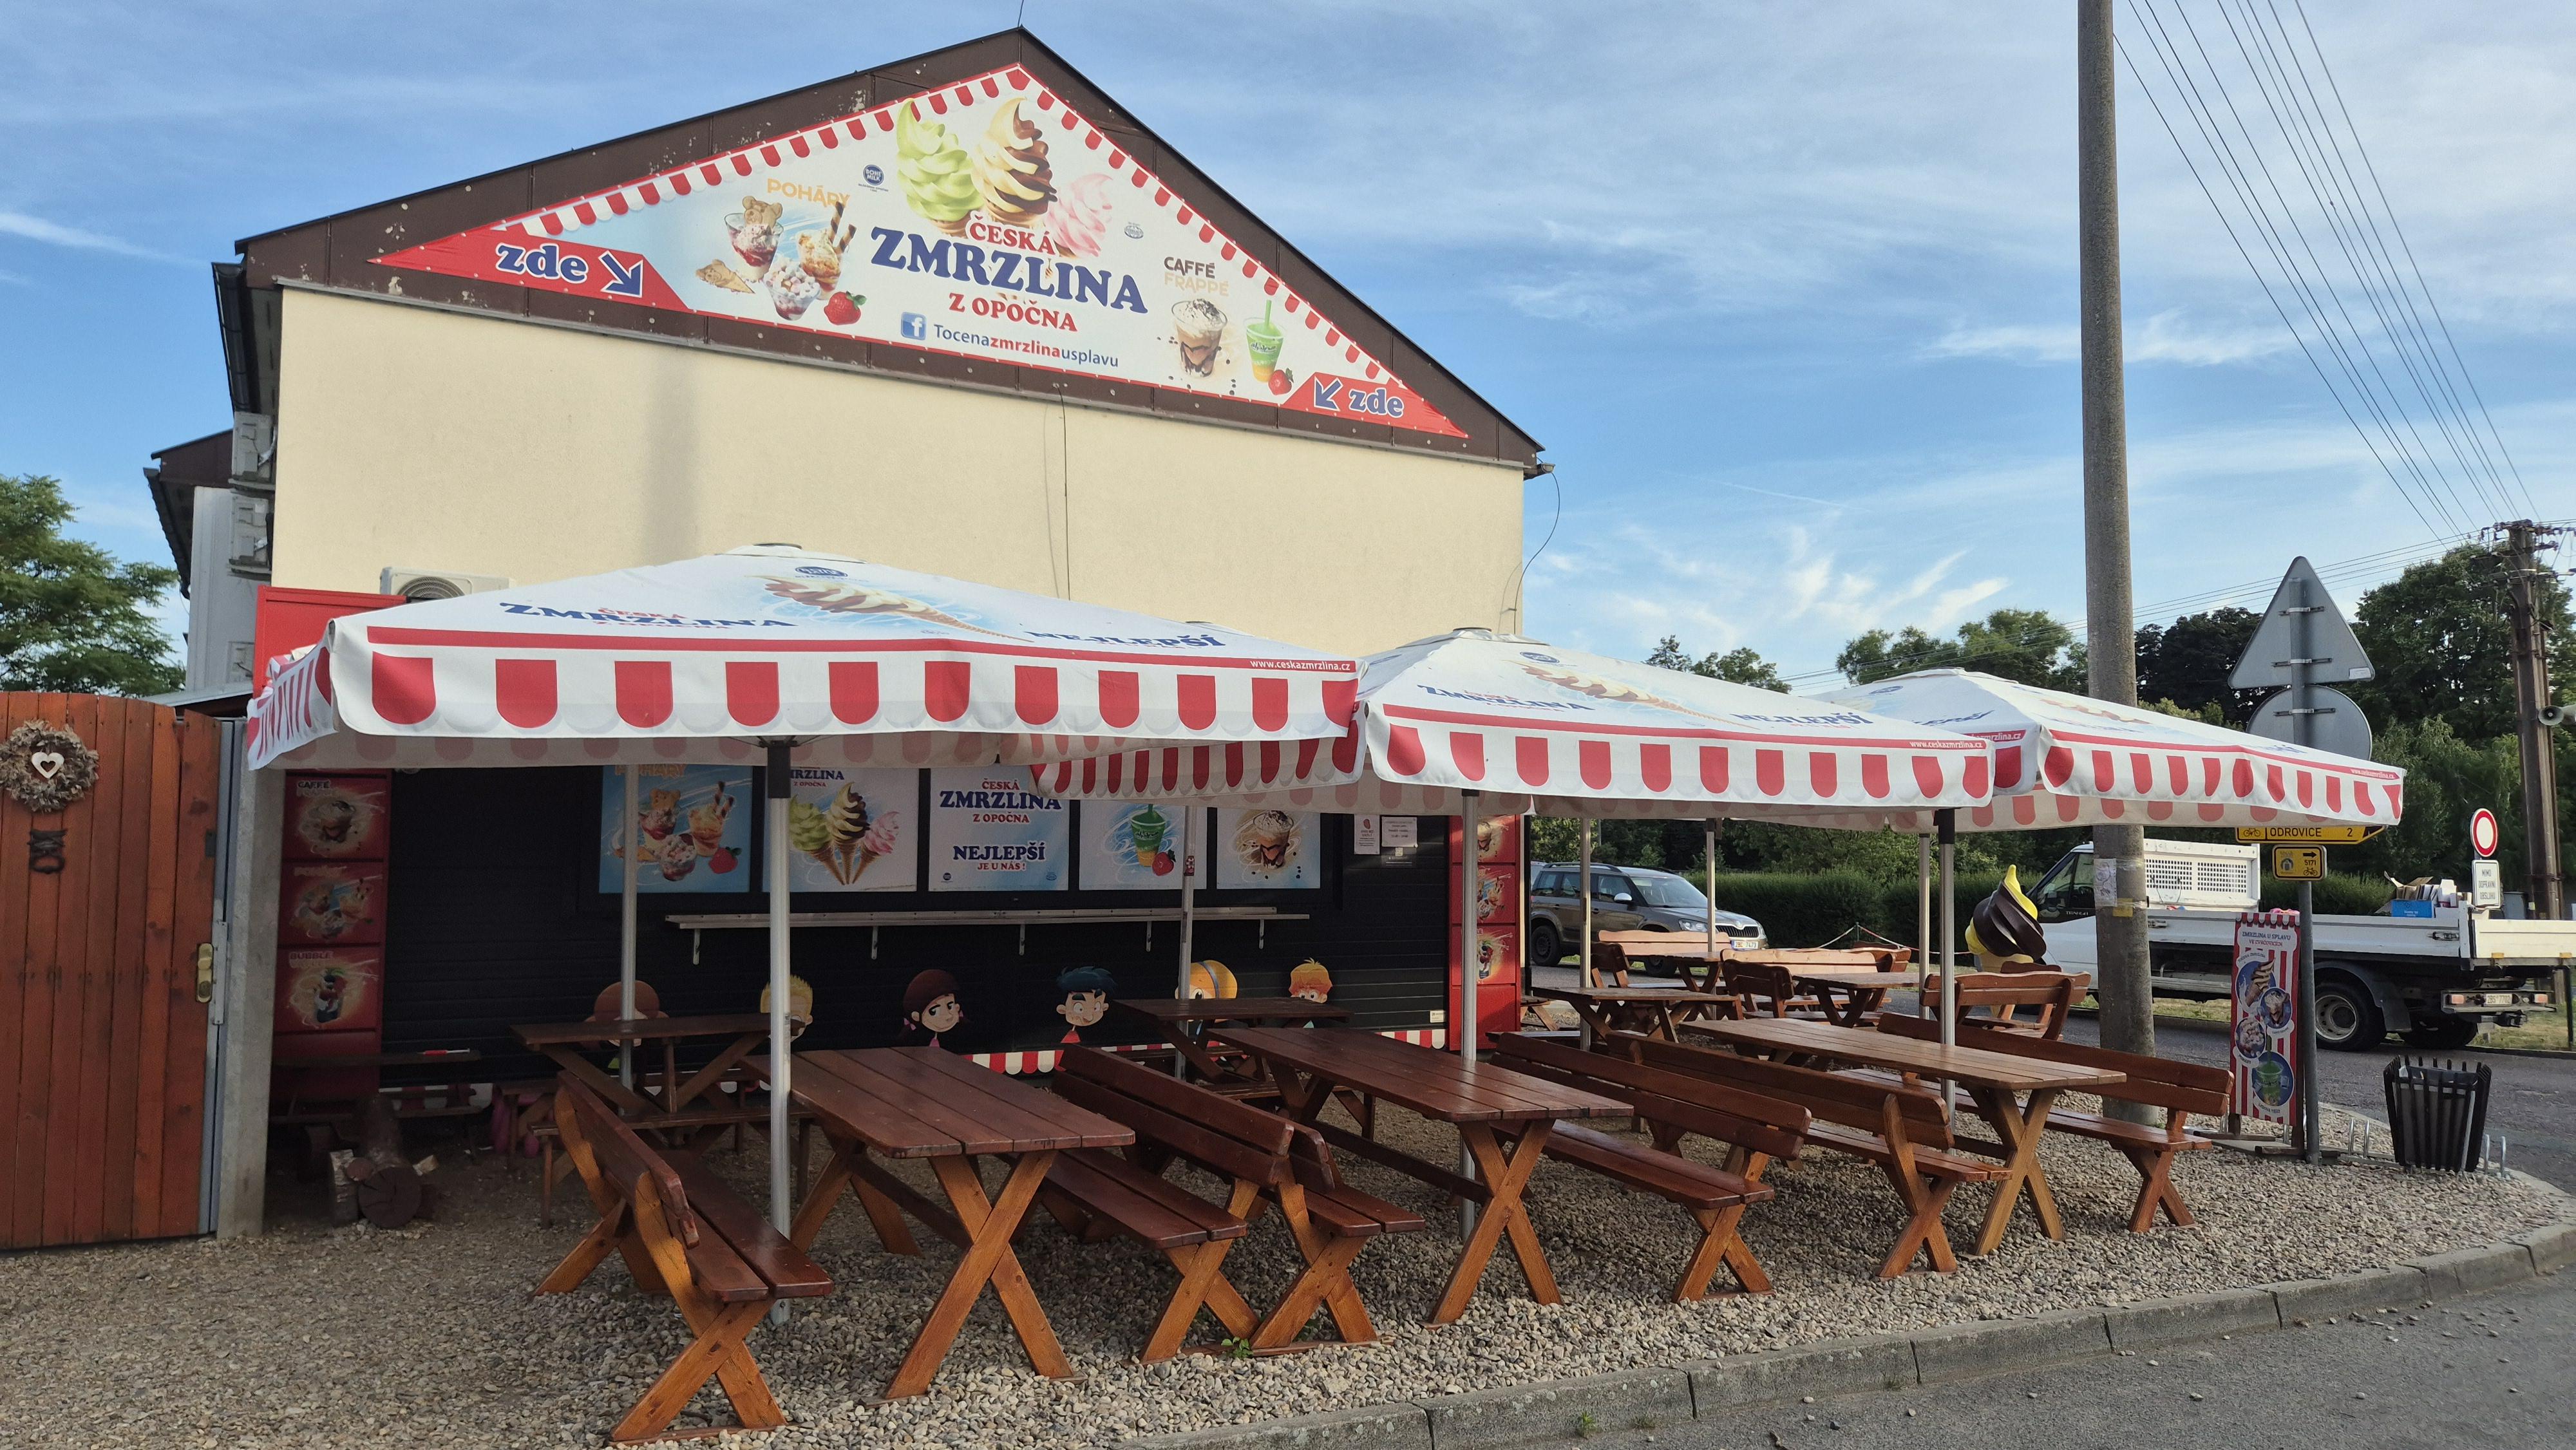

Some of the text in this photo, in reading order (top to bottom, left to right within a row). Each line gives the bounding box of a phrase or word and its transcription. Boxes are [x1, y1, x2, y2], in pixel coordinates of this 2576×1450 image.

[767, 178, 851, 208] POHÁRY
[969, 215, 1056, 255] ČESKÁ
[497, 243, 587, 283] zde
[871, 226, 1148, 314] ZMRZLINA
[1164, 256, 1215, 279] CAFFÉ
[1164, 272, 1229, 297] FRAPPÉ
[949, 292, 1078, 332] Z OPOČNA
[934, 325, 1119, 368] Tocenazmrzlinausplavu
[1349, 388, 1403, 417] zde
[500, 602, 799, 626] ZMRZLINA
[1250, 661, 1350, 671] www.ceskazmrzlina.cz
[1417, 684, 1595, 711] ZMRZLINA
[1730, 712, 1873, 724] NEJLEPŠÍ
[1909, 740, 1983, 749] www.ceskazmrzlina.cz
[982, 778, 1019, 790] ČESKÁ
[940, 791, 1062, 809] ZMRZLINA
[973, 811, 1030, 823] Z OPOČNA
[2270, 827, 2353, 837] ODROVICE 2
[953, 842, 1045, 860] NEJLEPŠÍ
